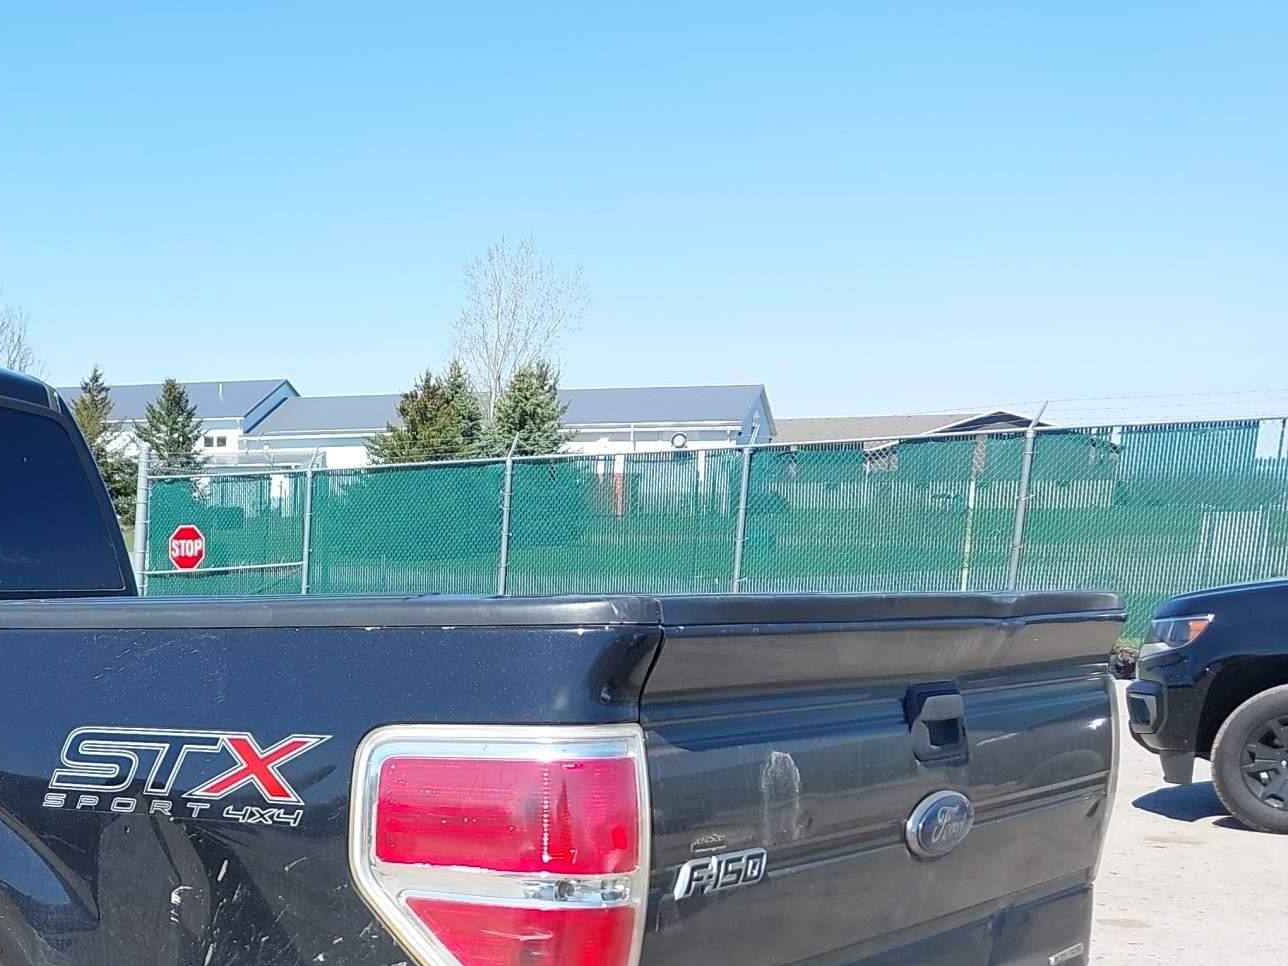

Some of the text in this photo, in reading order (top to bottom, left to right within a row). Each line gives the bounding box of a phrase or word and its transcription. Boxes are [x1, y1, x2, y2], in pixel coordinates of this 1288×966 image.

[172, 539, 202, 557] STOP
[48, 726, 333, 806] STX
[43, 793, 211, 818] SPORT
[932, 804, 969, 843] Ford
